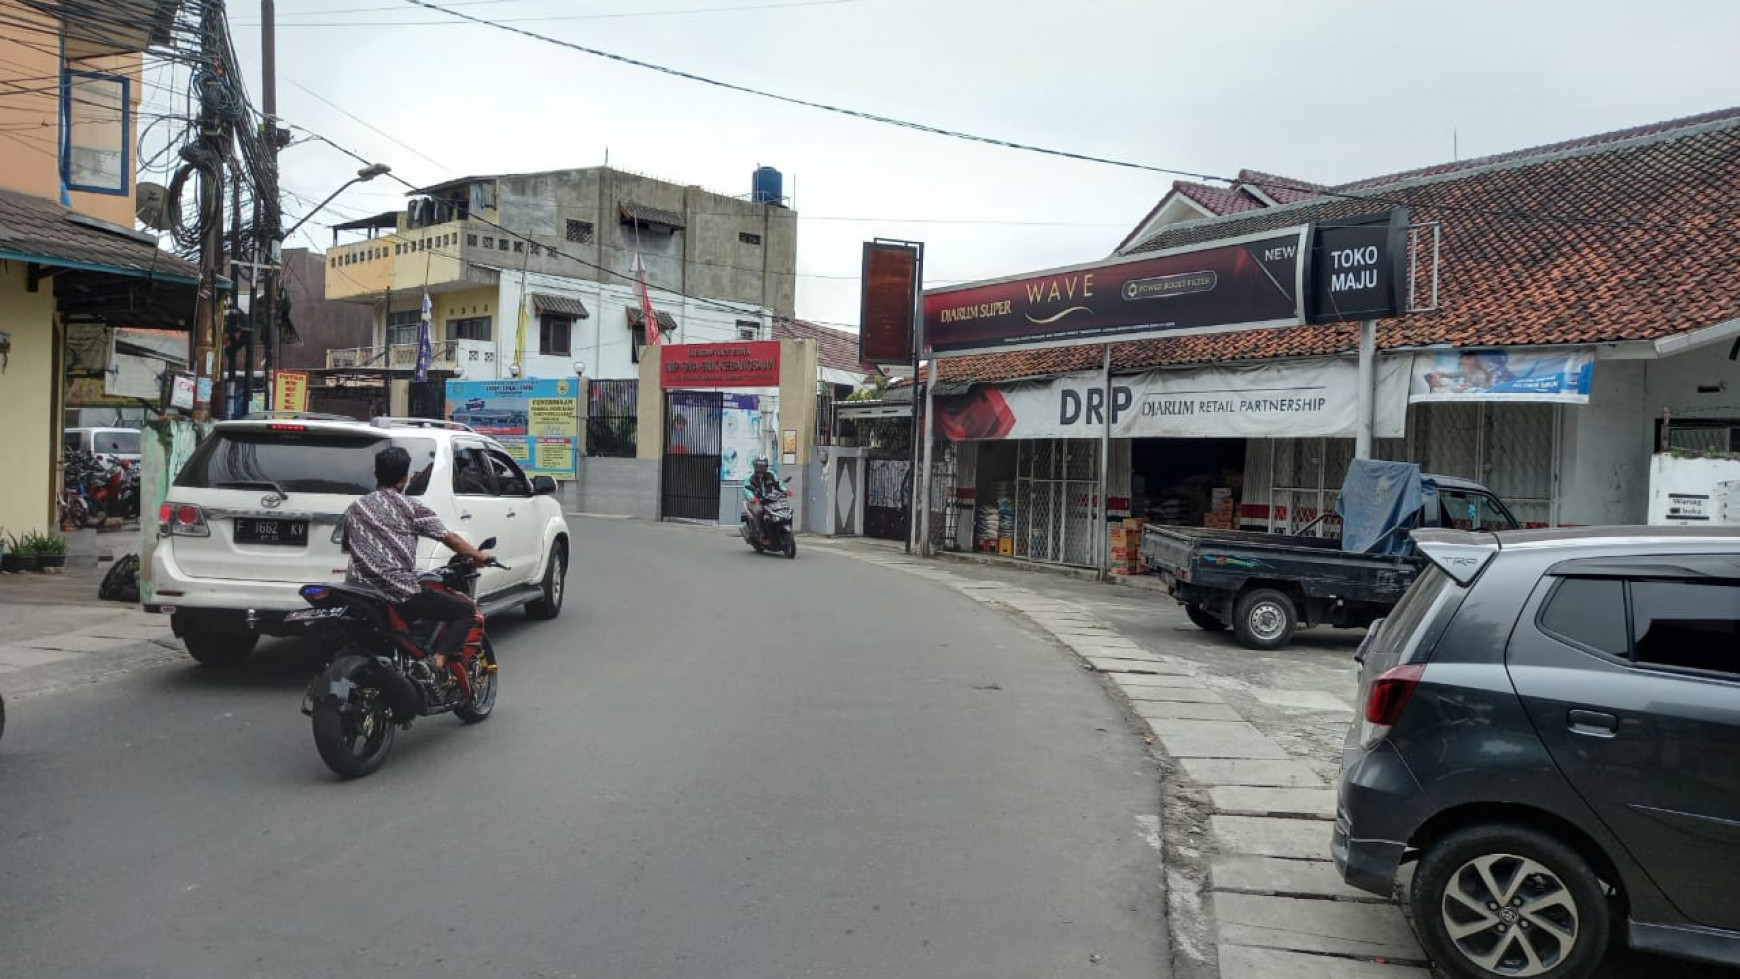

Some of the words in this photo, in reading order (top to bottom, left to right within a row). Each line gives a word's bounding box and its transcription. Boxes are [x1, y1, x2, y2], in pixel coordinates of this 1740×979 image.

[1265, 246, 1296, 262] NEW
[1331, 246, 1378, 269] TOKO
[1026, 274, 1094, 305] WAVE
[1331, 269, 1378, 293] MAJU
[941, 305, 978, 324] DJARUM
[979, 300, 1011, 318] SUPER
[1060, 386, 1133, 425] DRP
[1141, 400, 1195, 418] DJARUM
[1198, 400, 1235, 413] RETAIL
[1239, 397, 1326, 413] PARTNERSHIP
[237, 520, 245, 532] F
[255, 522, 278, 534] 1662
[1441, 556, 1477, 566] TRD
